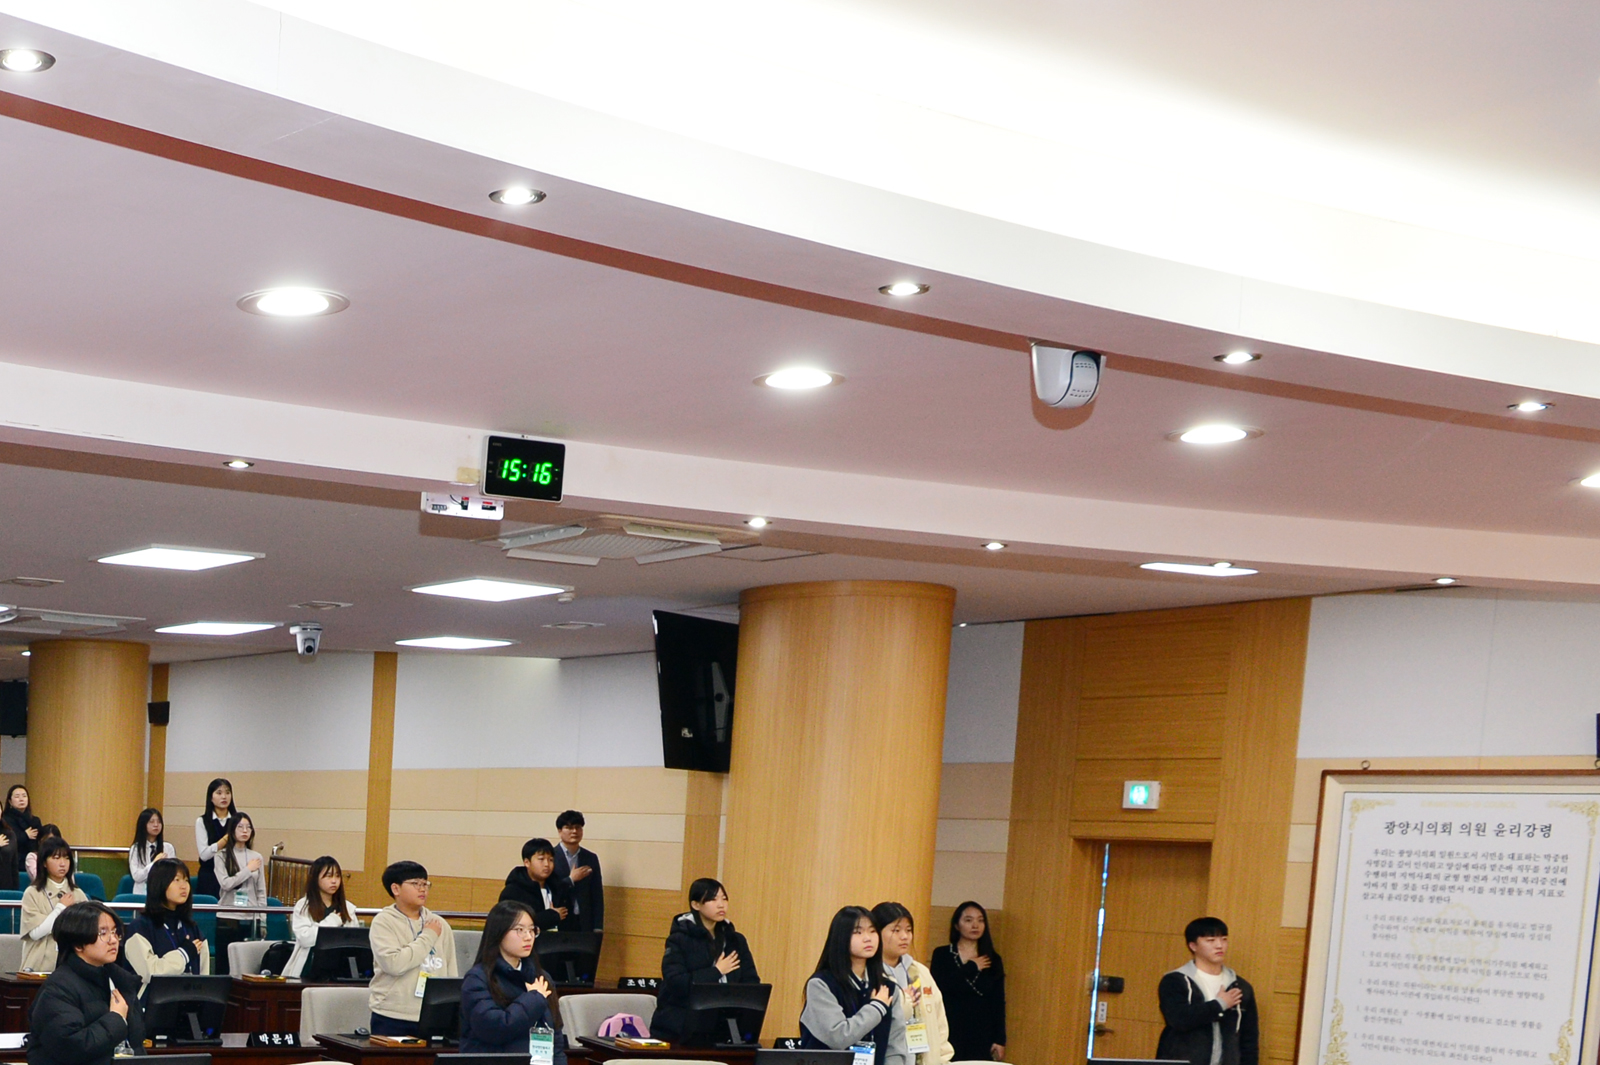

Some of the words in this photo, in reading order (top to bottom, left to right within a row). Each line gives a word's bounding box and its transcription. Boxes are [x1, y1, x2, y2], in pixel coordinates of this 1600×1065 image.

[501, 458, 552, 485] 15:16
[1384, 820, 1452, 836] 광양시의회
[1458, 822, 1487, 837] 의원
[1493, 822, 1552, 838] 윤리강령
[258, 1033, 294, 1045] 박문섭
